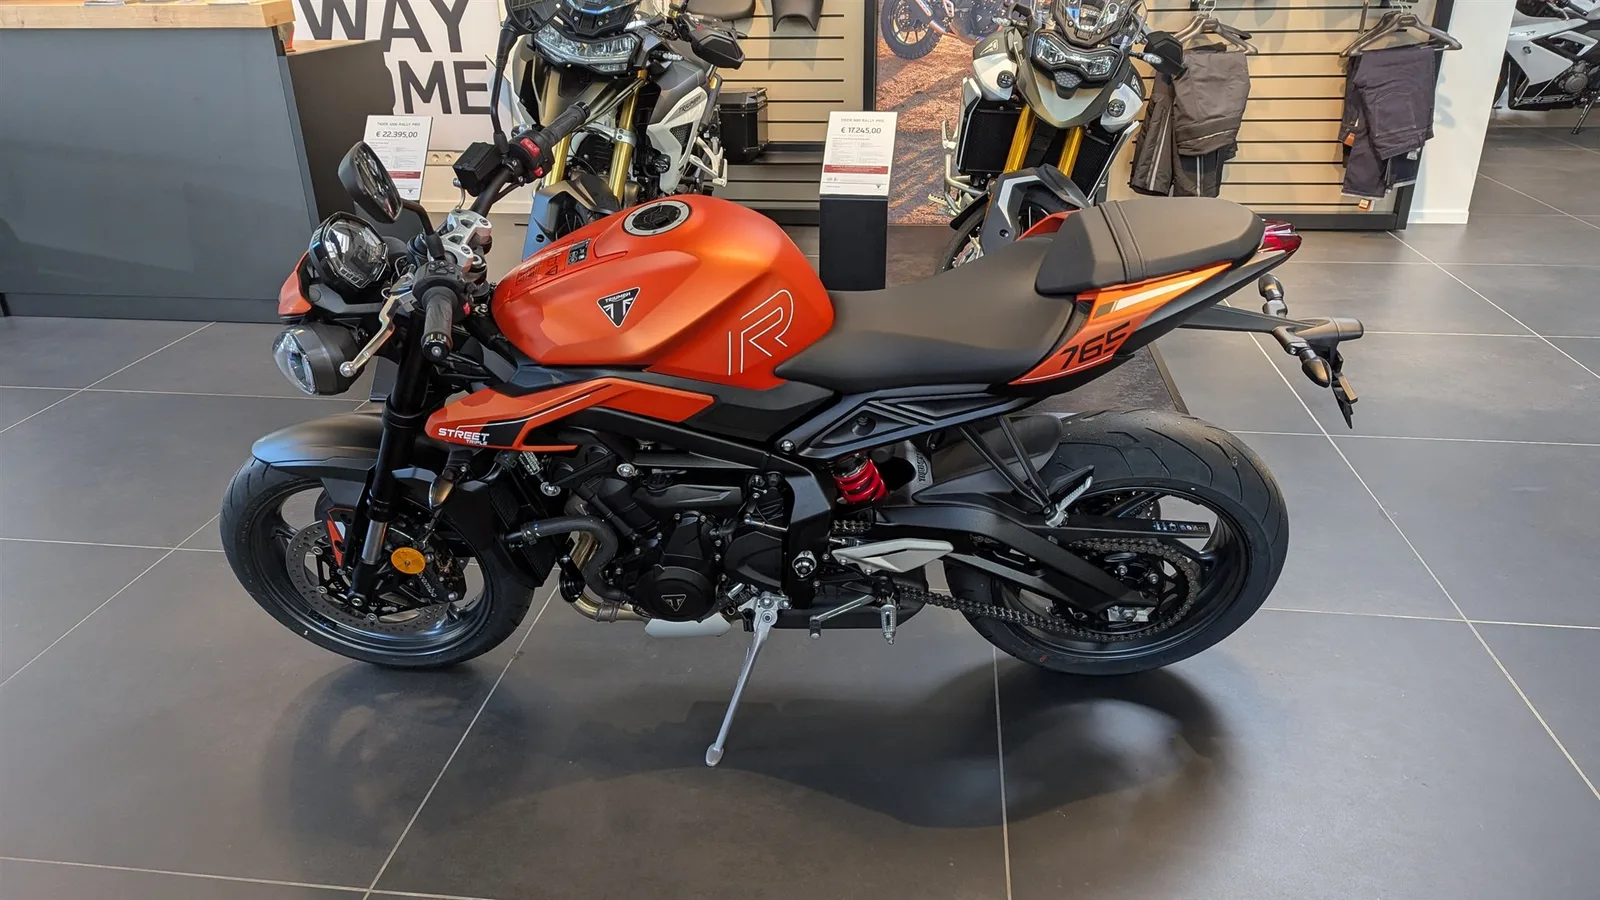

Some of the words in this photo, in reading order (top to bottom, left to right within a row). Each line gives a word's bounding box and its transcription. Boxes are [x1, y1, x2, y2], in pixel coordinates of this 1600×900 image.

[299, 0, 470, 53] WAY
[1059, 320, 1131, 370] 765
[438, 427, 490, 441] STREET
